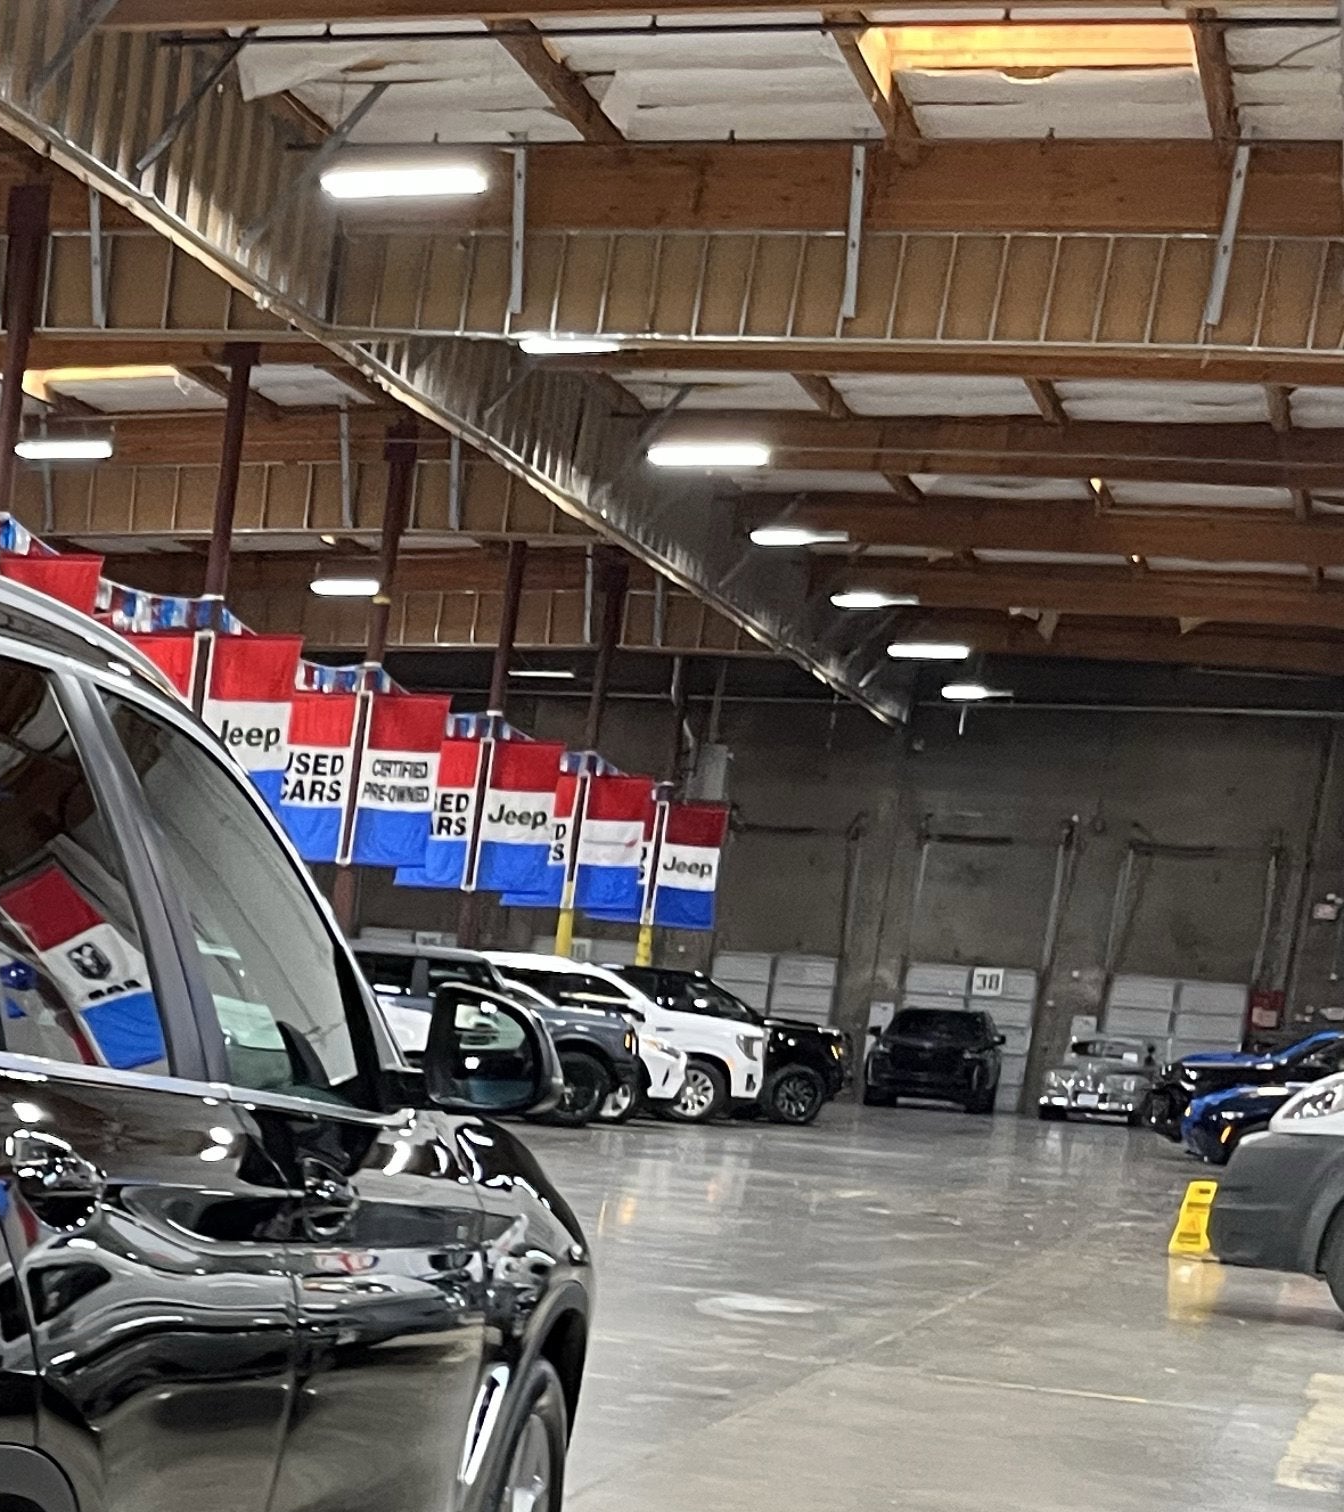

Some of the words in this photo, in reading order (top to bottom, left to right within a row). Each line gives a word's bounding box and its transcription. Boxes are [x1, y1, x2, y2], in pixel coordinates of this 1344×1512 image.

[220, 719, 281, 752] Jeep
[281, 779, 342, 802] ARS
[433, 793, 470, 813] ED
[429, 816, 467, 836] RS
[487, 803, 548, 831] Jeep
[662, 856, 713, 878] Jeep
